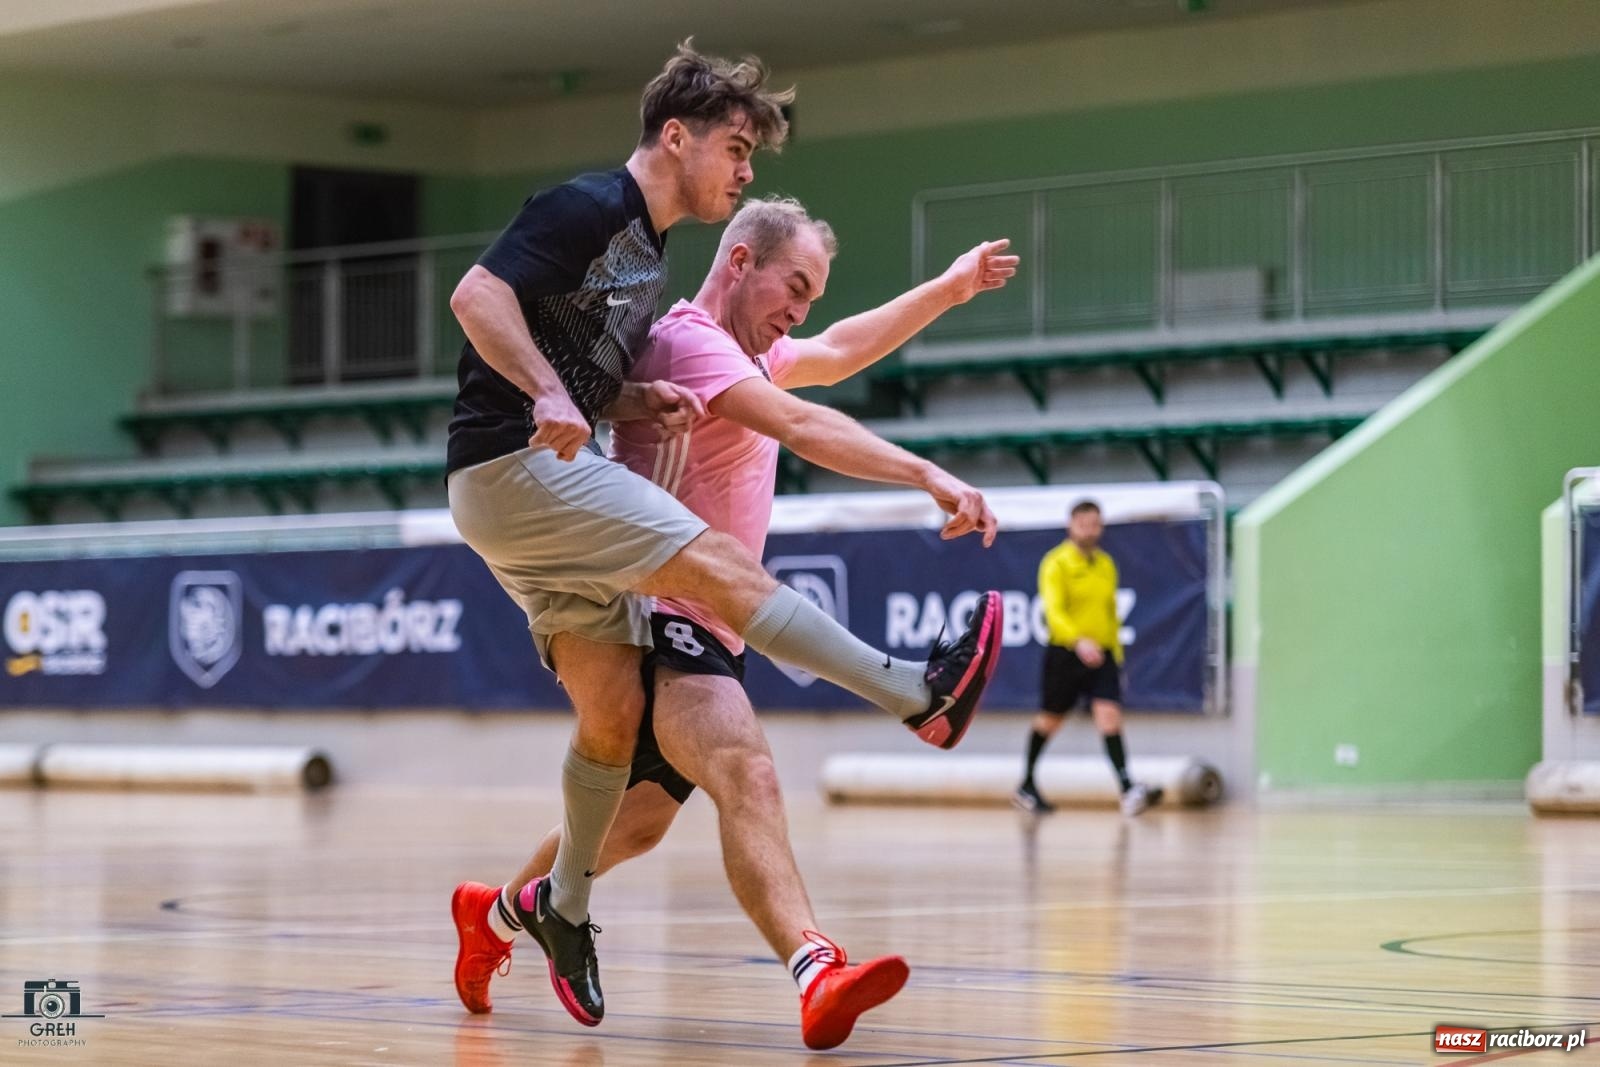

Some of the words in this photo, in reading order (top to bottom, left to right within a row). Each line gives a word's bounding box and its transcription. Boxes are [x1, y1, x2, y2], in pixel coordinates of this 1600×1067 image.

[263, 587, 463, 656] RACIBÓRZ
[664, 621, 704, 656] 8
[886, 588, 1137, 648] RACBZ
